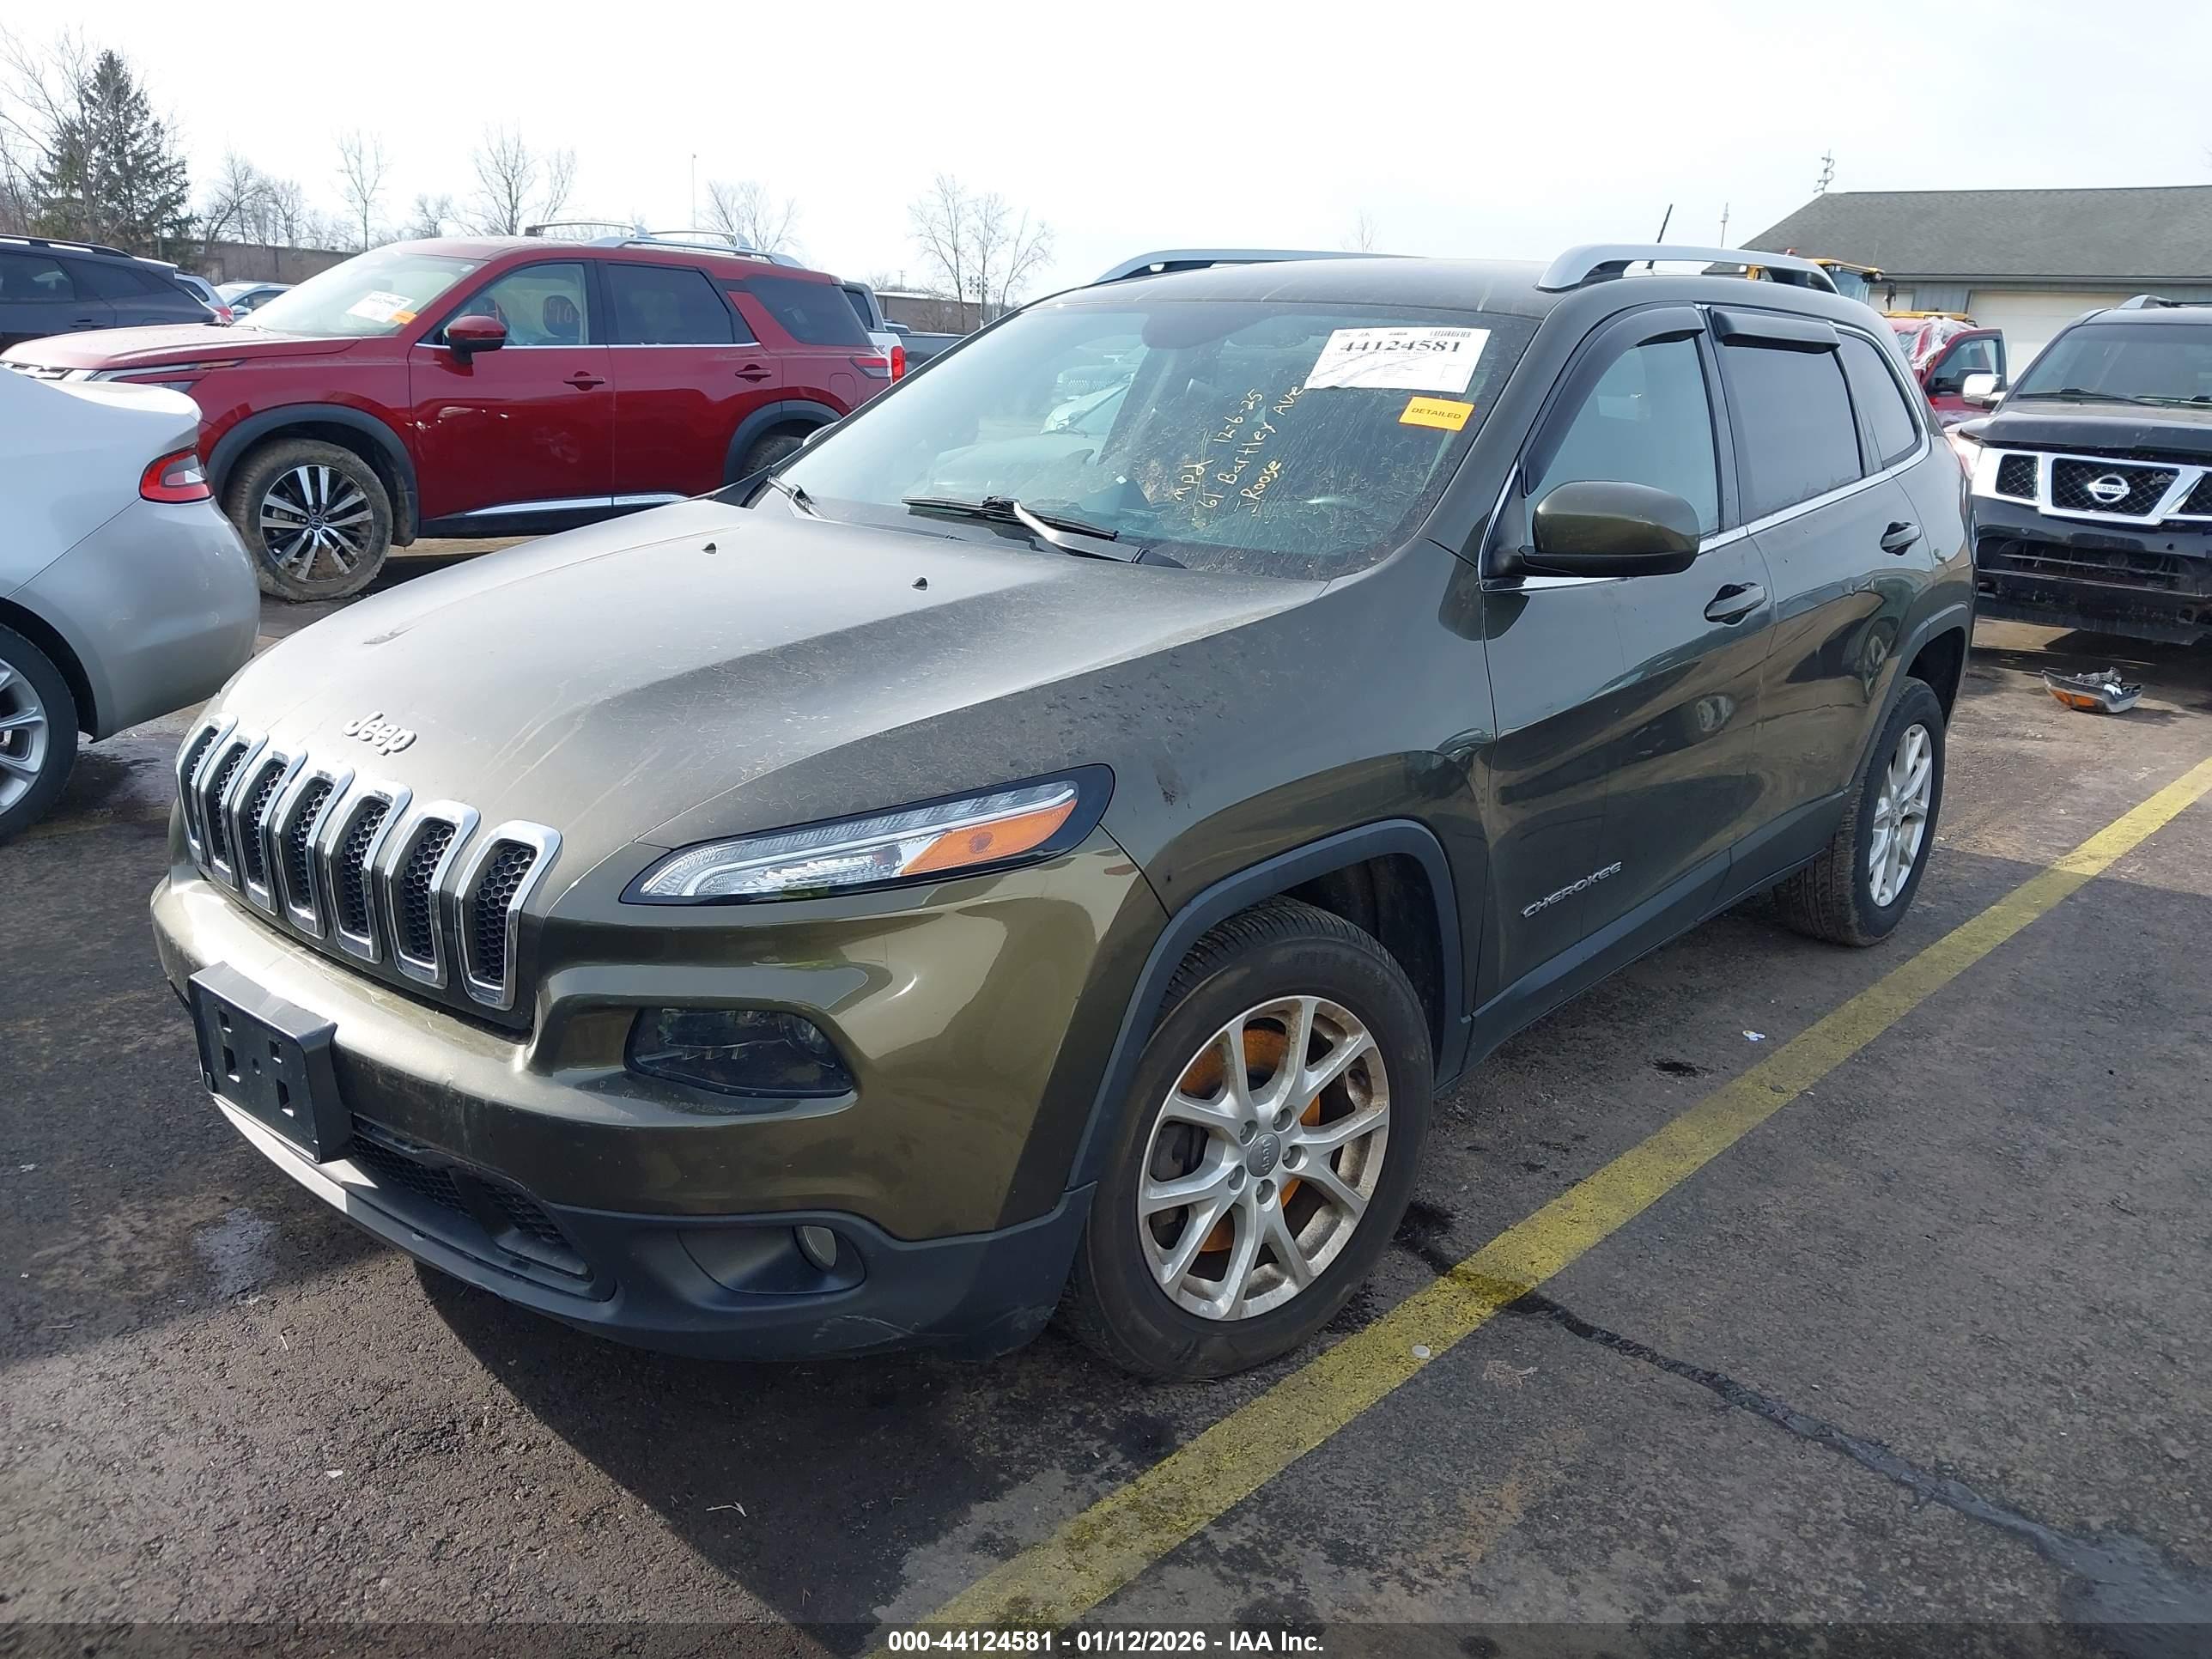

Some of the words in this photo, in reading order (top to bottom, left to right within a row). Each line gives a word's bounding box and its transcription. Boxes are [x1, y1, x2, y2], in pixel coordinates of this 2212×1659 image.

[1340, 340, 1462, 353] 44124581
[1213, 388, 1263, 442] 12-6-25
[1411, 407, 1462, 420] DETAILED
[1218, 422, 1276, 484] Bartley
[343, 711, 416, 756] Jeep
[1522, 860, 1622, 918] CHEROKEE
[1261, 1139, 1271, 1171] Jeep
